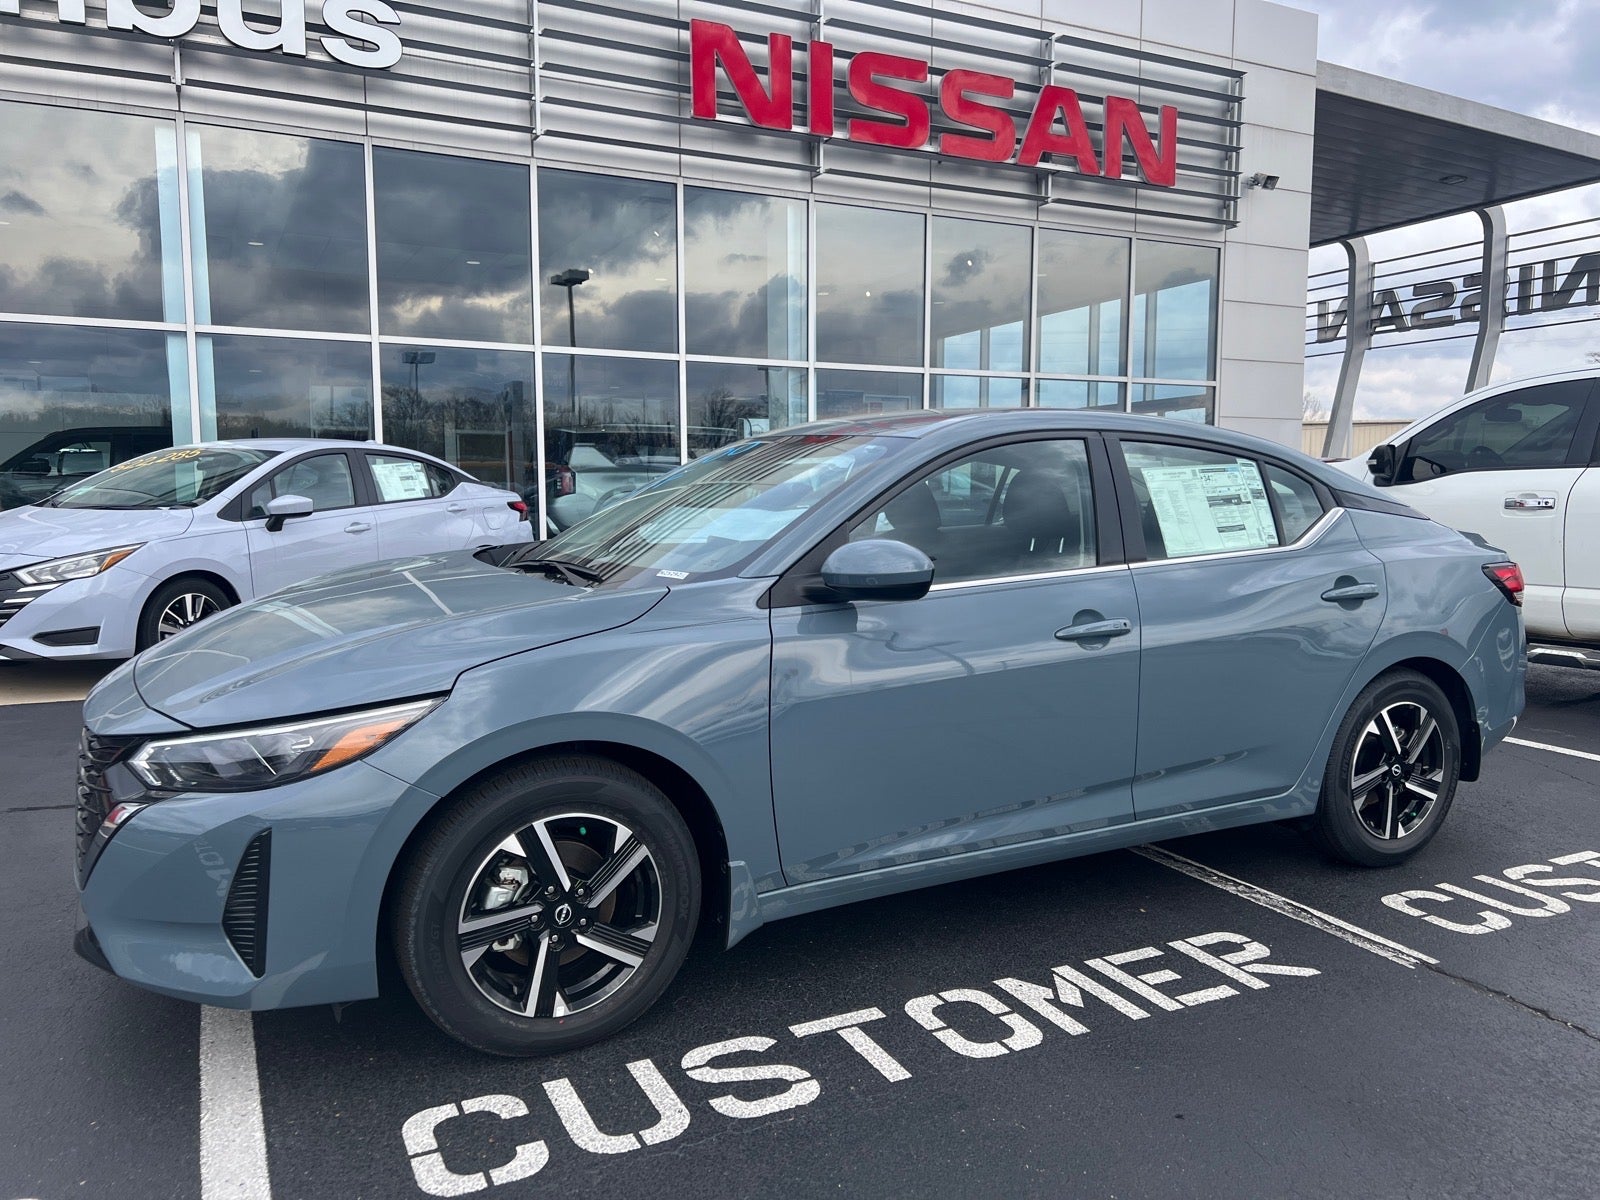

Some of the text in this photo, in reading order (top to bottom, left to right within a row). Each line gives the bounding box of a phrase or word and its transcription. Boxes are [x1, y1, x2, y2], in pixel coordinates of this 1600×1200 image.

[0, 0, 403, 69] us
[690, 18, 1178, 188] NISSAN
[402, 931, 1321, 1197] CUSTOMER
